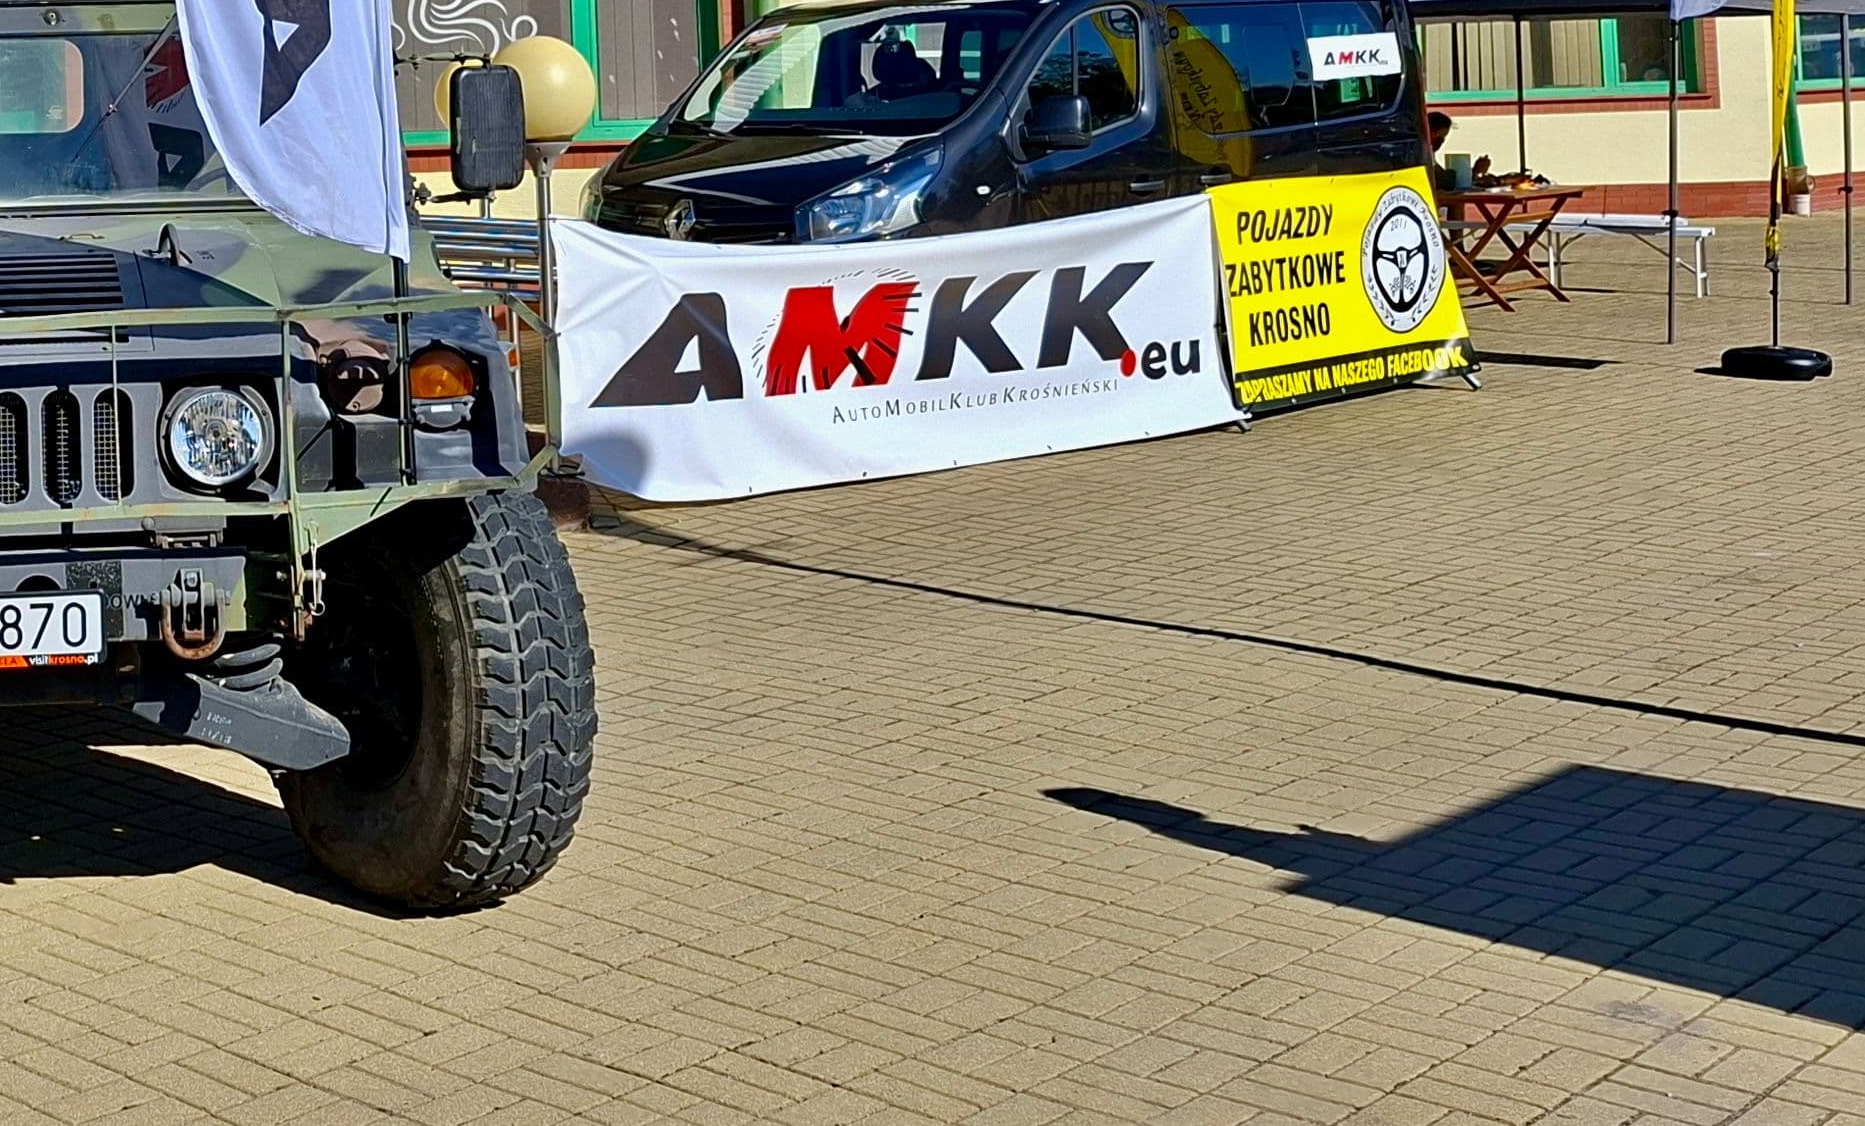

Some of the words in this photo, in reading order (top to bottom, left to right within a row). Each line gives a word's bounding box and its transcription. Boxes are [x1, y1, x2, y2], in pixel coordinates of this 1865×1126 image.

[1237, 203, 1334, 245] POJAZDY
[1226, 251, 1346, 298] ZABYTKOWE
[1249, 302, 1331, 348] KROSNO
[1314, 367, 1333, 392] NA
[1332, 356, 1385, 388] NASZEGO
[1387, 345, 1469, 378] FACEBOOK
[29, 653, 99, 666] visitkrosno.pl
